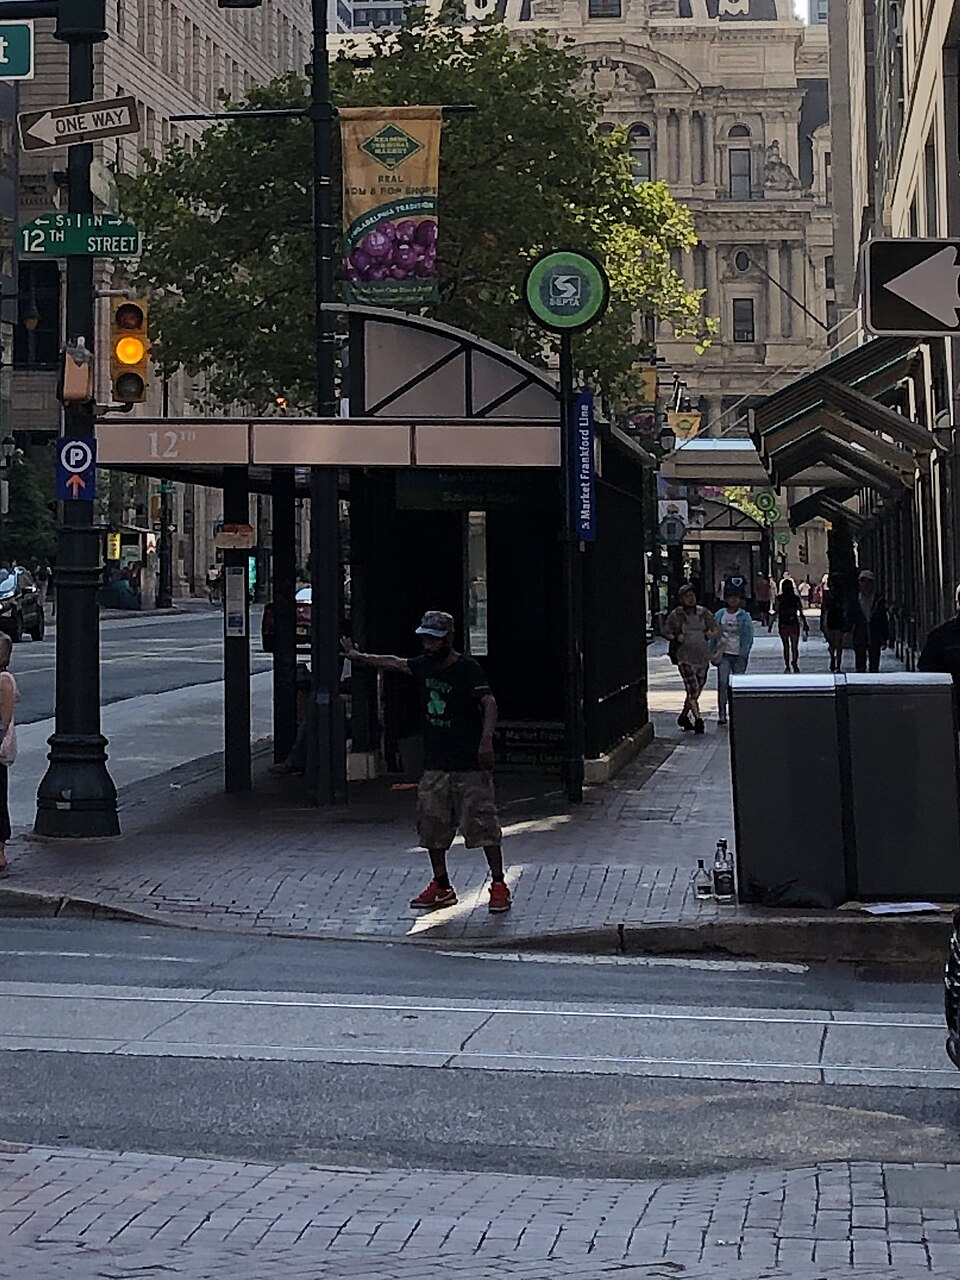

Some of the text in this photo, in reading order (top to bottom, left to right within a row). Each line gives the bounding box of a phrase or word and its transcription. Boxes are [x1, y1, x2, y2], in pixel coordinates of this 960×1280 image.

[55, 109, 124, 133] ONE WAY
[378, 175, 403, 183] REAL
[380, 187, 402, 195] POP
[87, 236, 136, 252] STREET
[549, 298, 580, 306] SEPTA
[579, 404, 591, 520] Market Frankford Line
